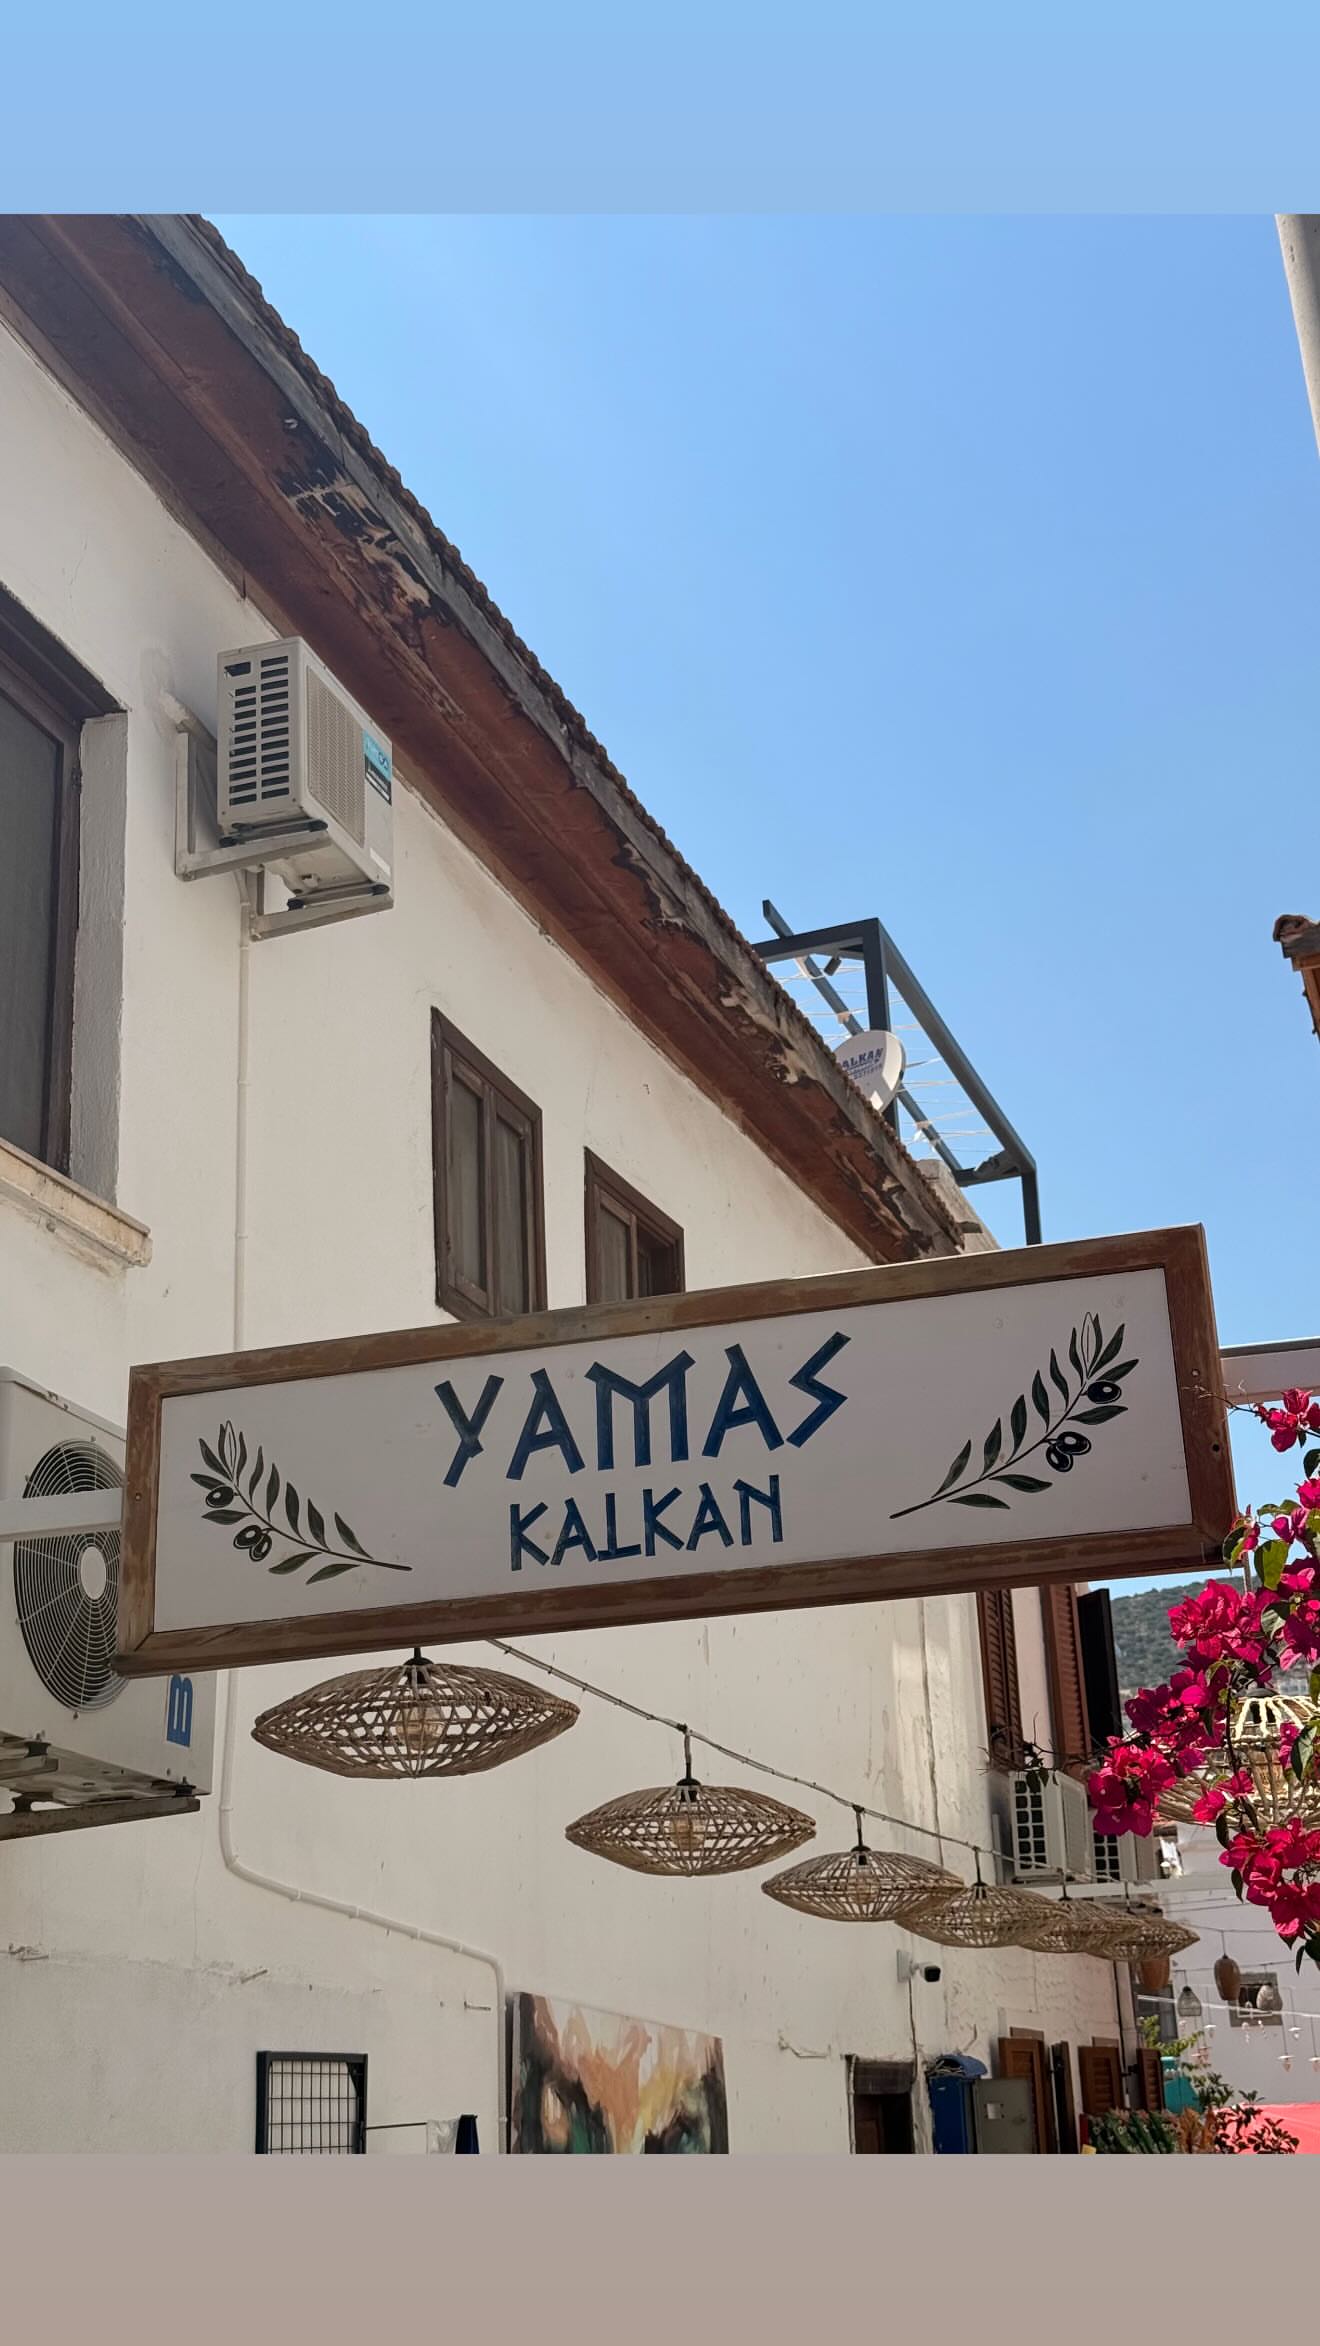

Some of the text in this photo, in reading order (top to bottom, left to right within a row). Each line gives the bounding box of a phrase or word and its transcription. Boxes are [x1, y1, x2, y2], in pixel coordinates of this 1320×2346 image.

[842, 1047, 883, 1068] ALKAN
[434, 1331, 852, 1488] YAMAS
[509, 1474, 784, 1571] KALKAN
